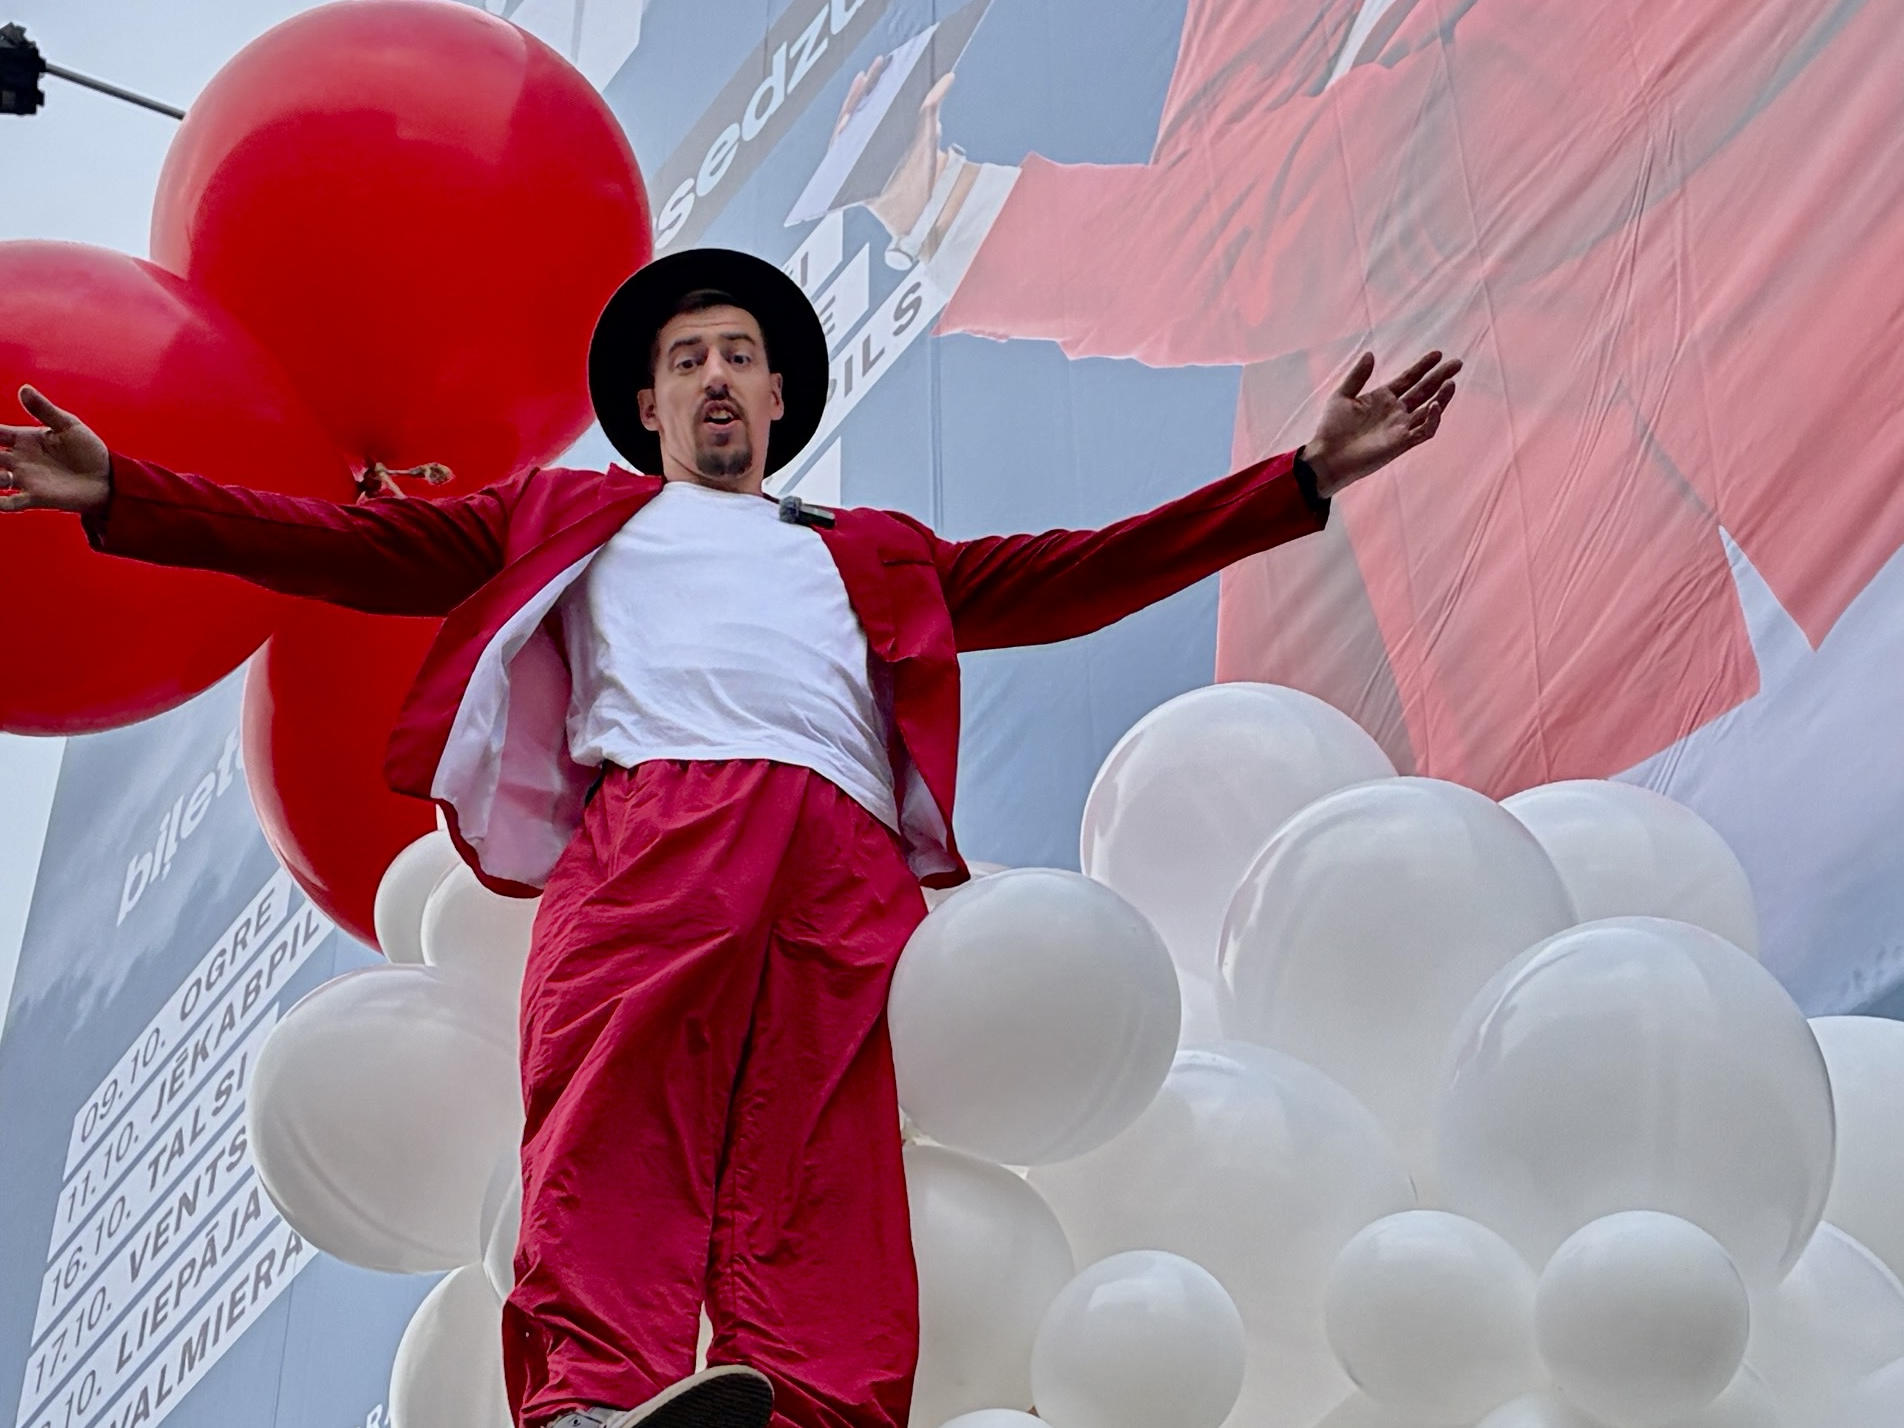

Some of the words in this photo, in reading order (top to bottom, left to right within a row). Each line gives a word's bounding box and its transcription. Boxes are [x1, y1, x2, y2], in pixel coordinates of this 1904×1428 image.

[116, 726, 243, 928] biļet
[180, 887, 275, 1022] OGRE
[148, 1051, 248, 1192] TALSI
[116, 1185, 261, 1374] LIEPĀJA
[129, 1125, 248, 1284] VENTS
